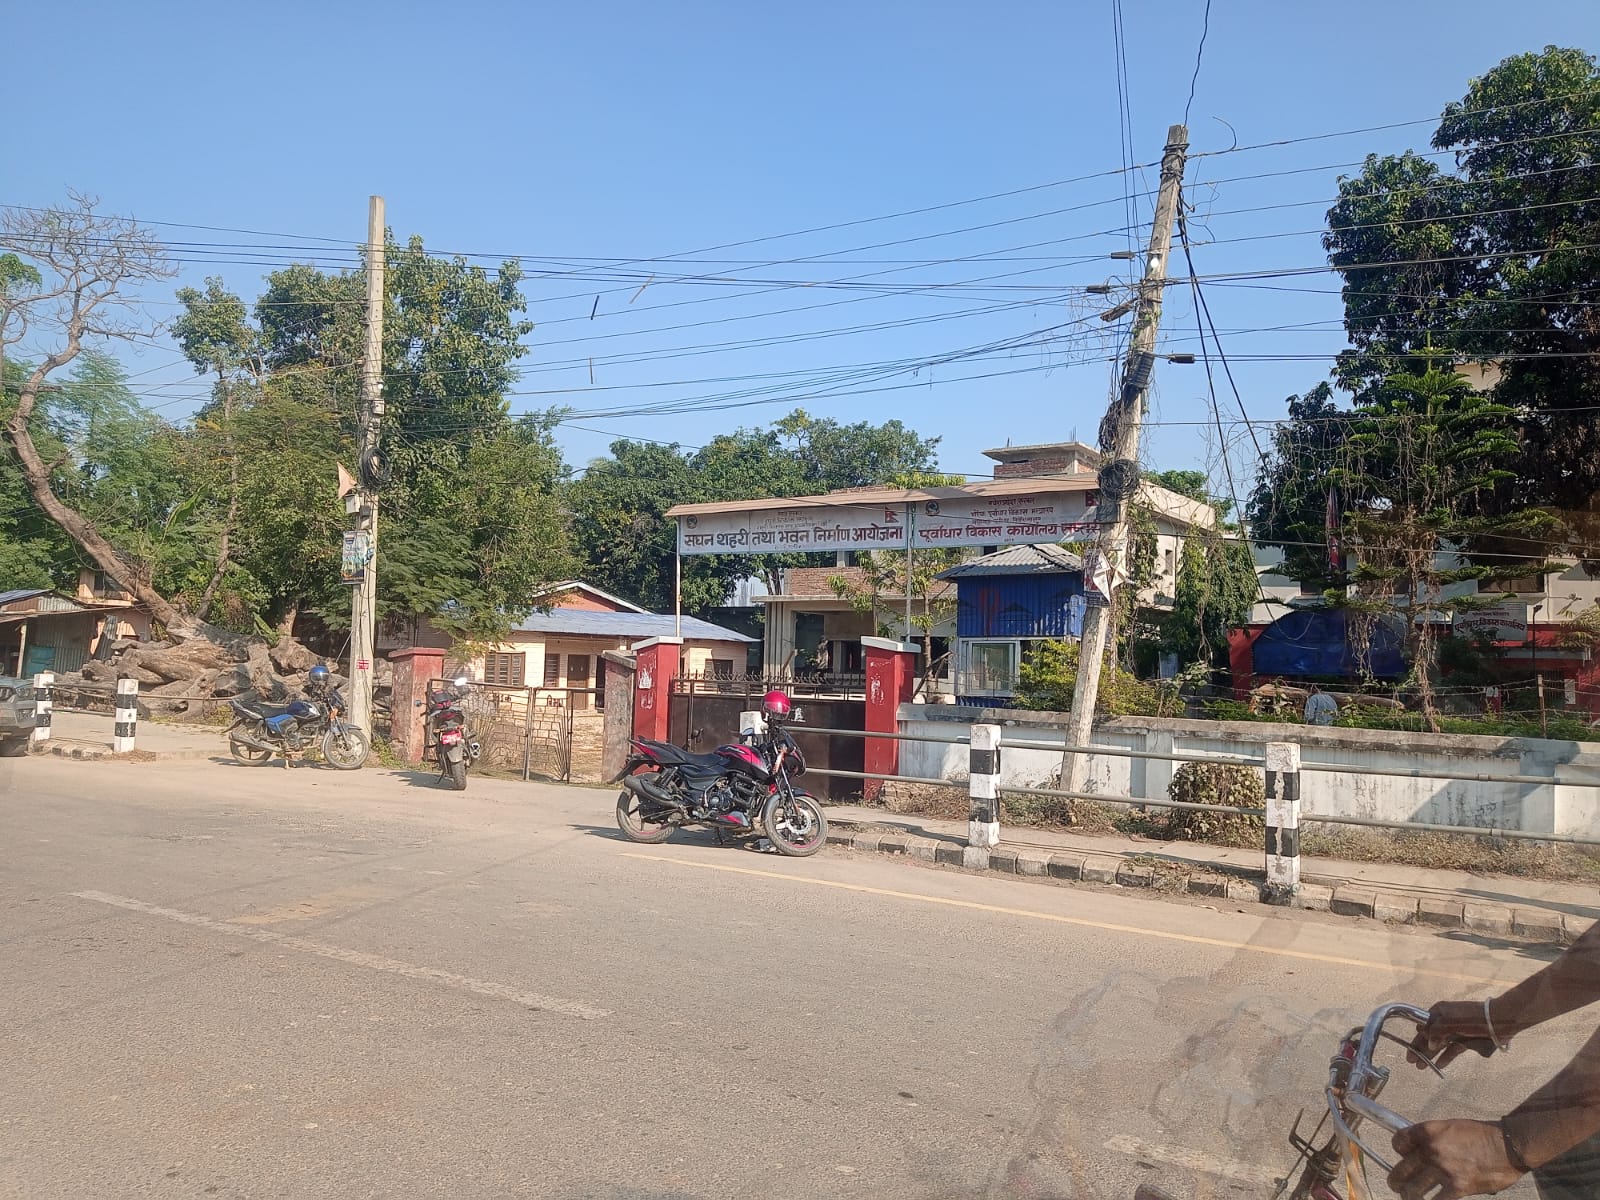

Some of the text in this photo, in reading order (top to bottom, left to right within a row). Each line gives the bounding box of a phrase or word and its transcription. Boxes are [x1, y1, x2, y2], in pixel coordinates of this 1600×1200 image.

[684, 534, 714, 547] सघन
[716, 528, 750, 549] शहरी
[751, 531, 775, 546] तथा
[778, 529, 809, 544] भवन
[813, 525, 850, 543] निर्माण
[852, 523, 903, 542] आयोजना
[918, 525, 962, 543] पूर्वाधार
[965, 524, 1002, 538] विकास
[1006, 521, 1058, 537] कार्यालय
